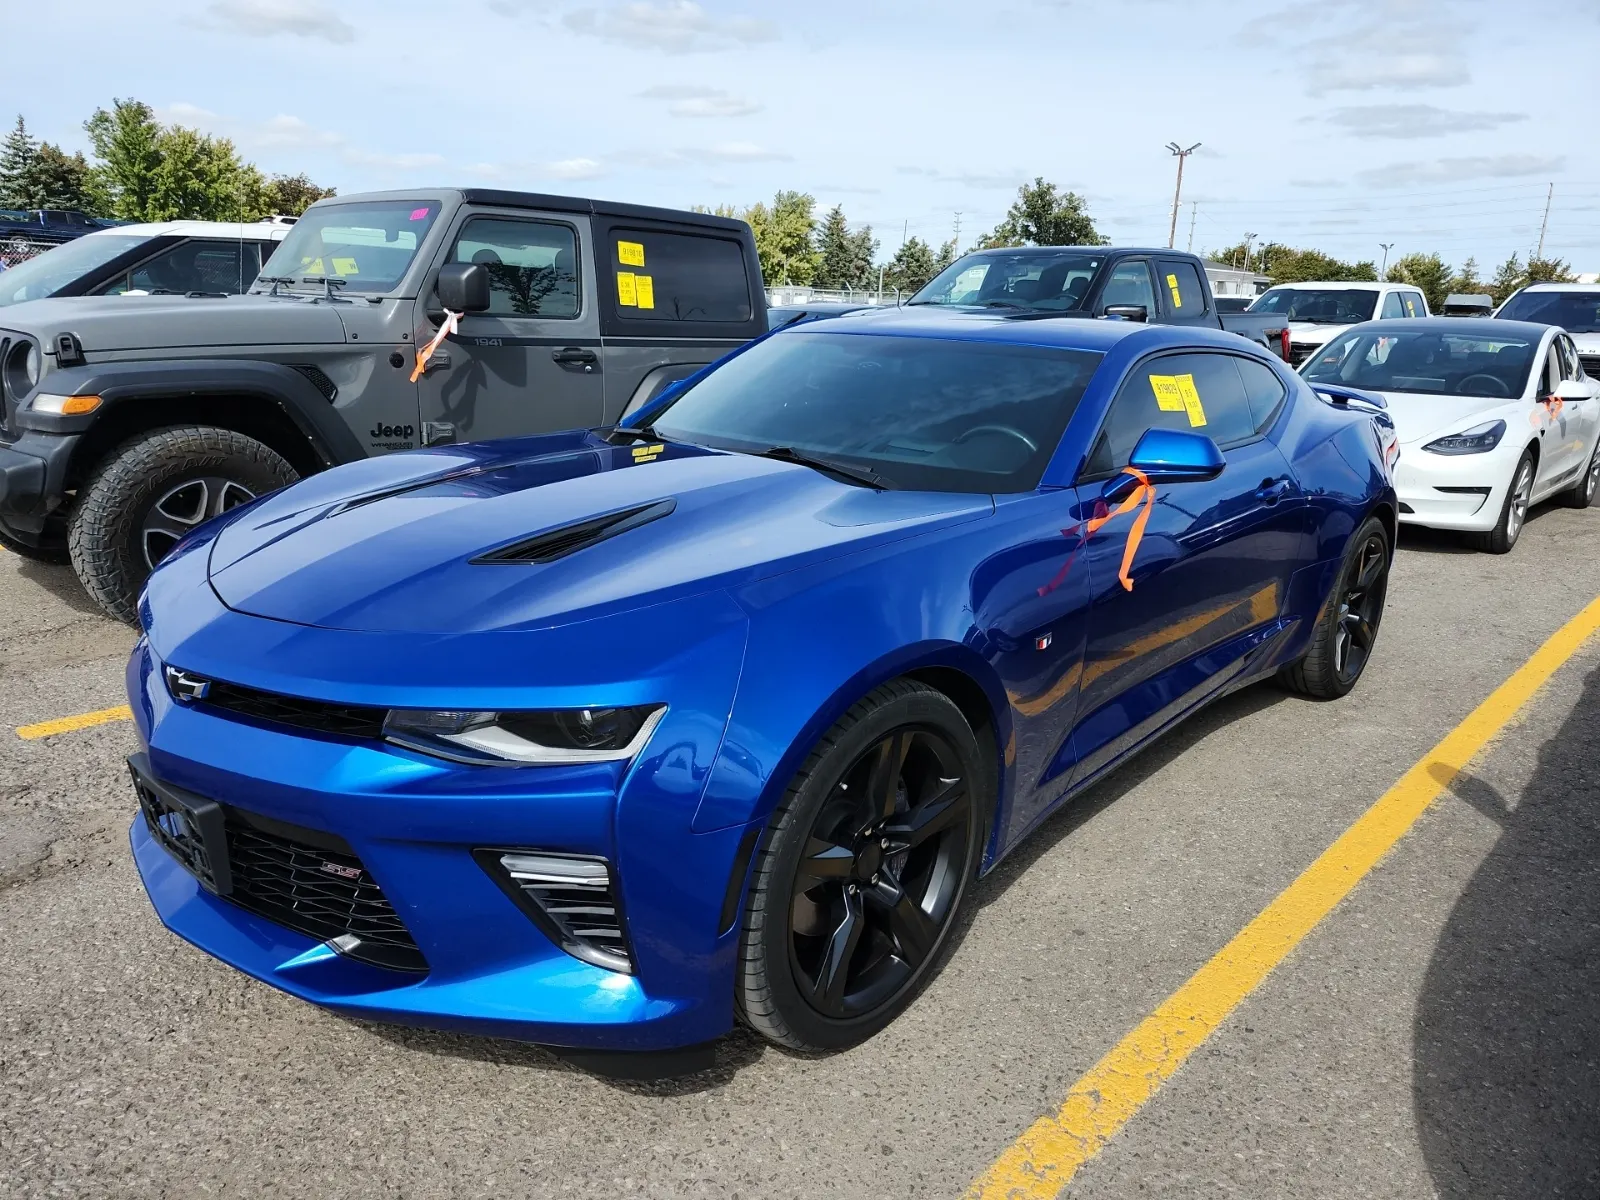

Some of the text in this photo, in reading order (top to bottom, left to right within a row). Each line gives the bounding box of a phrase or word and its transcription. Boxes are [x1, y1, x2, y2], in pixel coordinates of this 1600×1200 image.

[475, 338, 502, 347] 1941
[370, 422, 414, 439] Jeep
[320, 861, 361, 879] SS
